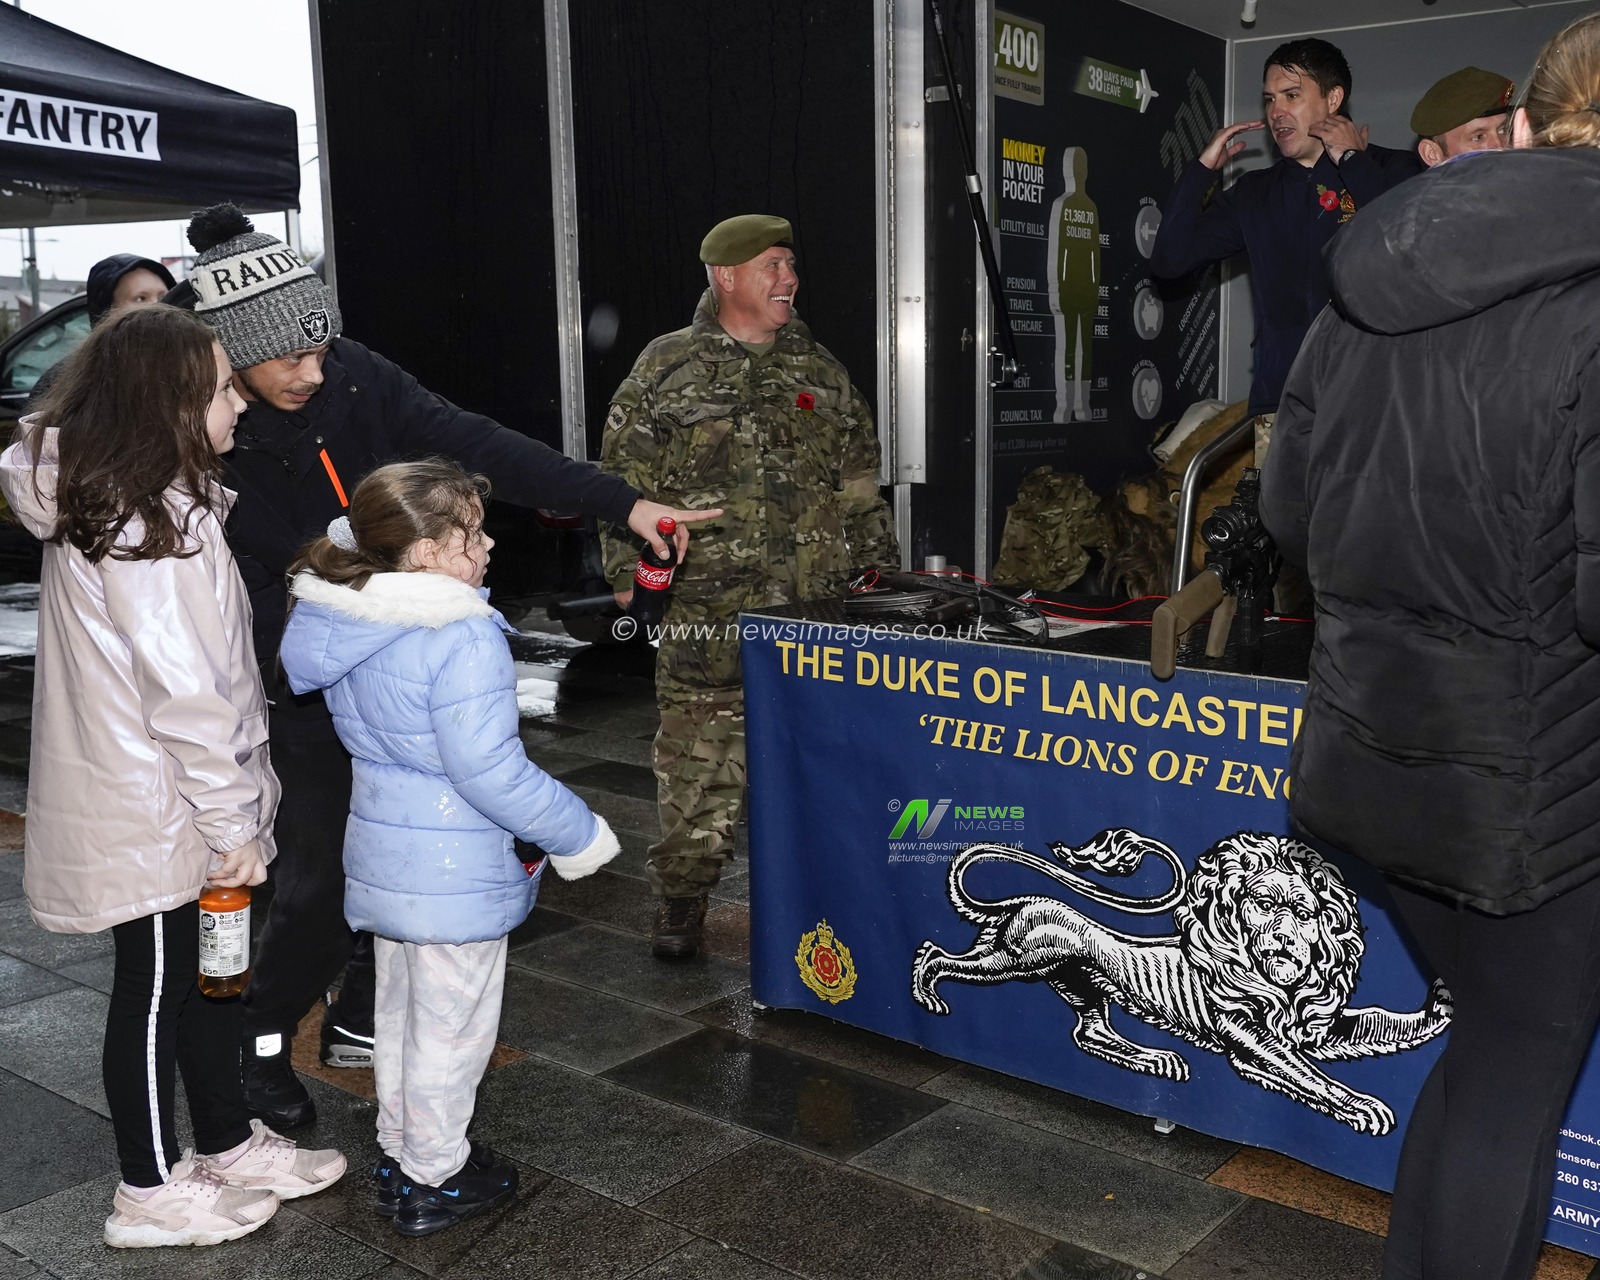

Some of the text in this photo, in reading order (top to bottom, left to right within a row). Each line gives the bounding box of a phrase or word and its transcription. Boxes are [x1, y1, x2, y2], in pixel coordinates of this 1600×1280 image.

[1088, 64, 1103, 92] 38
[1103, 70, 1134, 89] DAYS PAID
[1103, 84, 1121, 98] LEAVE
[1002, 138, 1046, 165] MONEY
[1003, 159, 1044, 185] IN YOUR
[1002, 179, 1045, 204] POCKET
[1064, 208, 1094, 224] £1,360.70
[1001, 219, 1044, 236] UTILITY BILLS
[1066, 225, 1091, 240] SOLDIER
[1099, 233, 1109, 245] REE
[1007, 277, 1036, 291] PENSION
[1098, 285, 1109, 297] REE
[1010, 298, 1033, 311] TRAVEL
[1098, 305, 1109, 317] REE
[1010, 319, 1042, 332] ALTHCARE
[1095, 325, 1109, 336] FREE
[1000, 409, 1042, 422] COUNCIL TAX
[775, 640, 844, 682] THE
[856, 650, 960, 699] DUKE
[973, 666, 1027, 707] OF
[1013, 729, 1137, 776] LIONS
[1147, 749, 1209, 785] OF
[1215, 759, 1290, 800] EN
[1556, 1170, 1579, 1186] 260
[1553, 1204, 1600, 1228] ARMY
